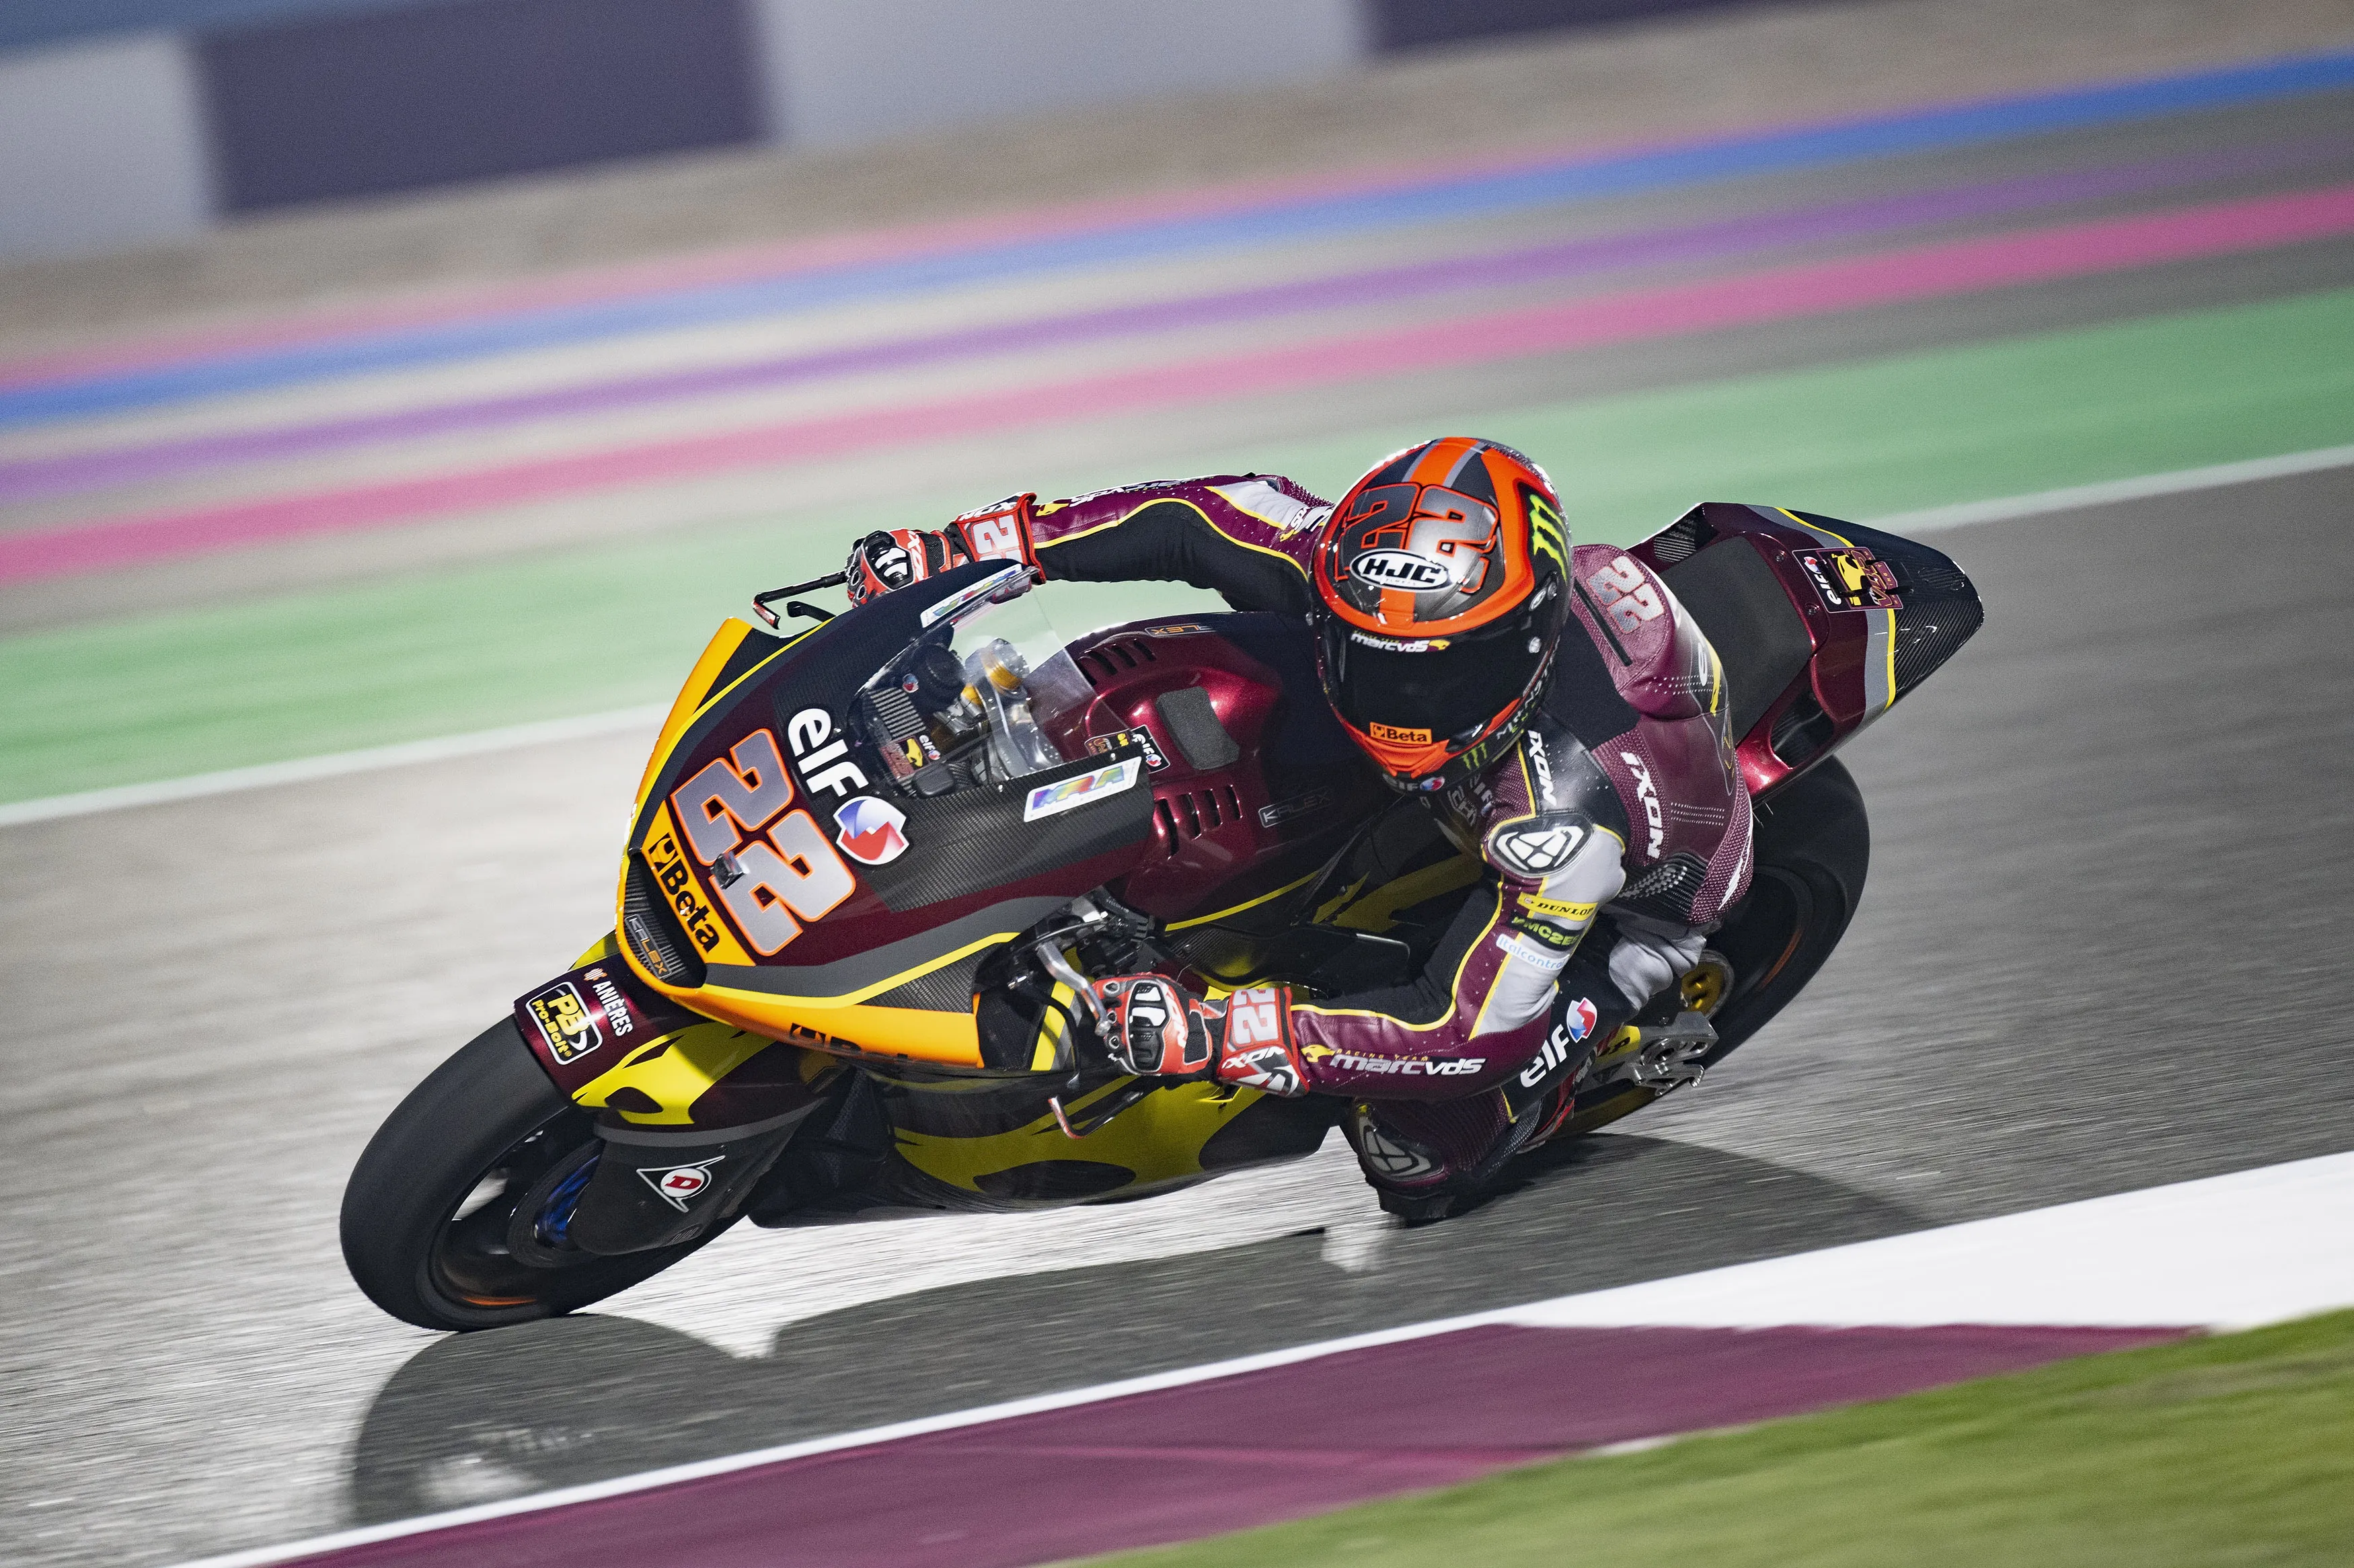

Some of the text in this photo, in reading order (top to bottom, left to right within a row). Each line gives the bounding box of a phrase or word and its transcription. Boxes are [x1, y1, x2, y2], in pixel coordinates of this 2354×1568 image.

[973, 514, 1023, 563] 2
[1363, 558, 1442, 584] HJC
[1589, 555, 1665, 634] 22
[1351, 633, 1430, 652] marcvds
[787, 707, 869, 797] elf
[919, 734, 936, 750] elf
[1387, 728, 1427, 742] Beta
[1621, 750, 1665, 859] iXON
[670, 728, 856, 957] 22
[661, 869, 720, 953] Beta
[630, 916, 671, 975] KALEX
[547, 993, 591, 1036] PB
[1330, 1054, 1487, 1075] marcvds
[1336, 1048, 1385, 1059] RACING
[1520, 1025, 1570, 1088] elf
